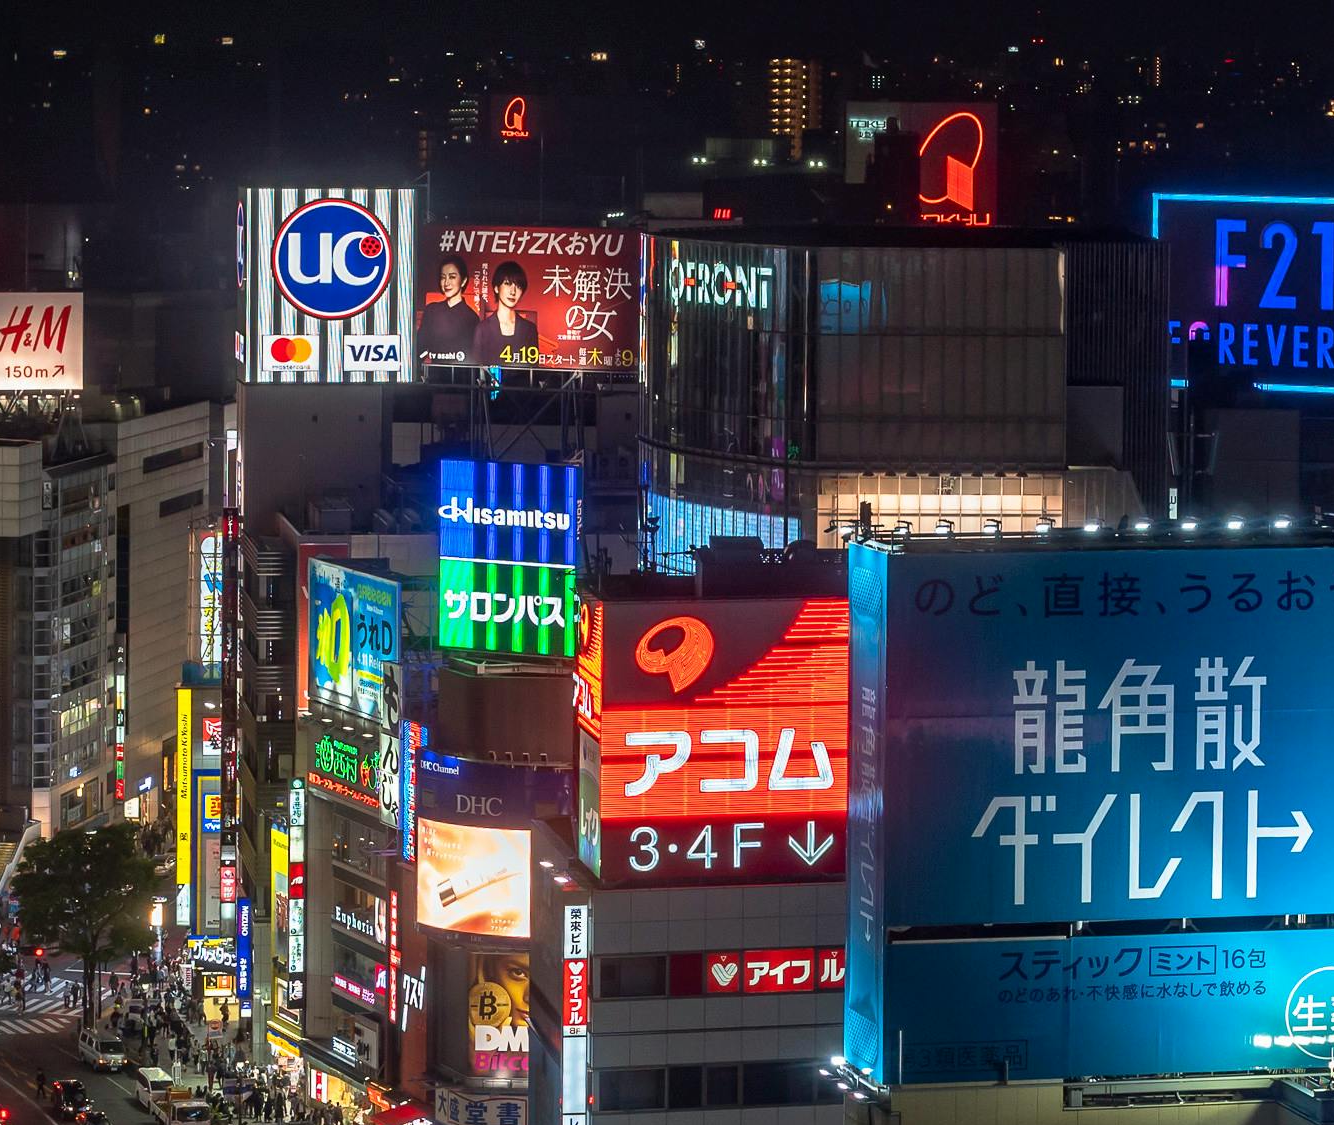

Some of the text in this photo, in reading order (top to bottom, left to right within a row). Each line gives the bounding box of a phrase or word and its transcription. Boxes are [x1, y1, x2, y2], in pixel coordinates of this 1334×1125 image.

[542, 264, 632, 303] 未解決
[565, 302, 617, 341] の女
[346, 344, 399, 362] VISA
[4, 364, 49, 379] 150m
[438, 497, 570, 531] Hisamitsu
[444, 588, 565, 629] サロンパス
[572, 671, 593, 720] アコム
[1013, 655, 1267, 775] 龍角散
[433, 763, 460, 776] Channel
[624, 727, 835, 798] アコム
[455, 794, 503, 818] DHC
[971, 790, 1314, 905] ダイレクト
[241, 905, 249, 937] MIZUHO
[335, 906, 374, 937] Euphoria
[747, 959, 846, 986] アイフル
[999, 947, 1267, 982] スティック ミント 16包
[568, 973, 584, 1024] アイフル
